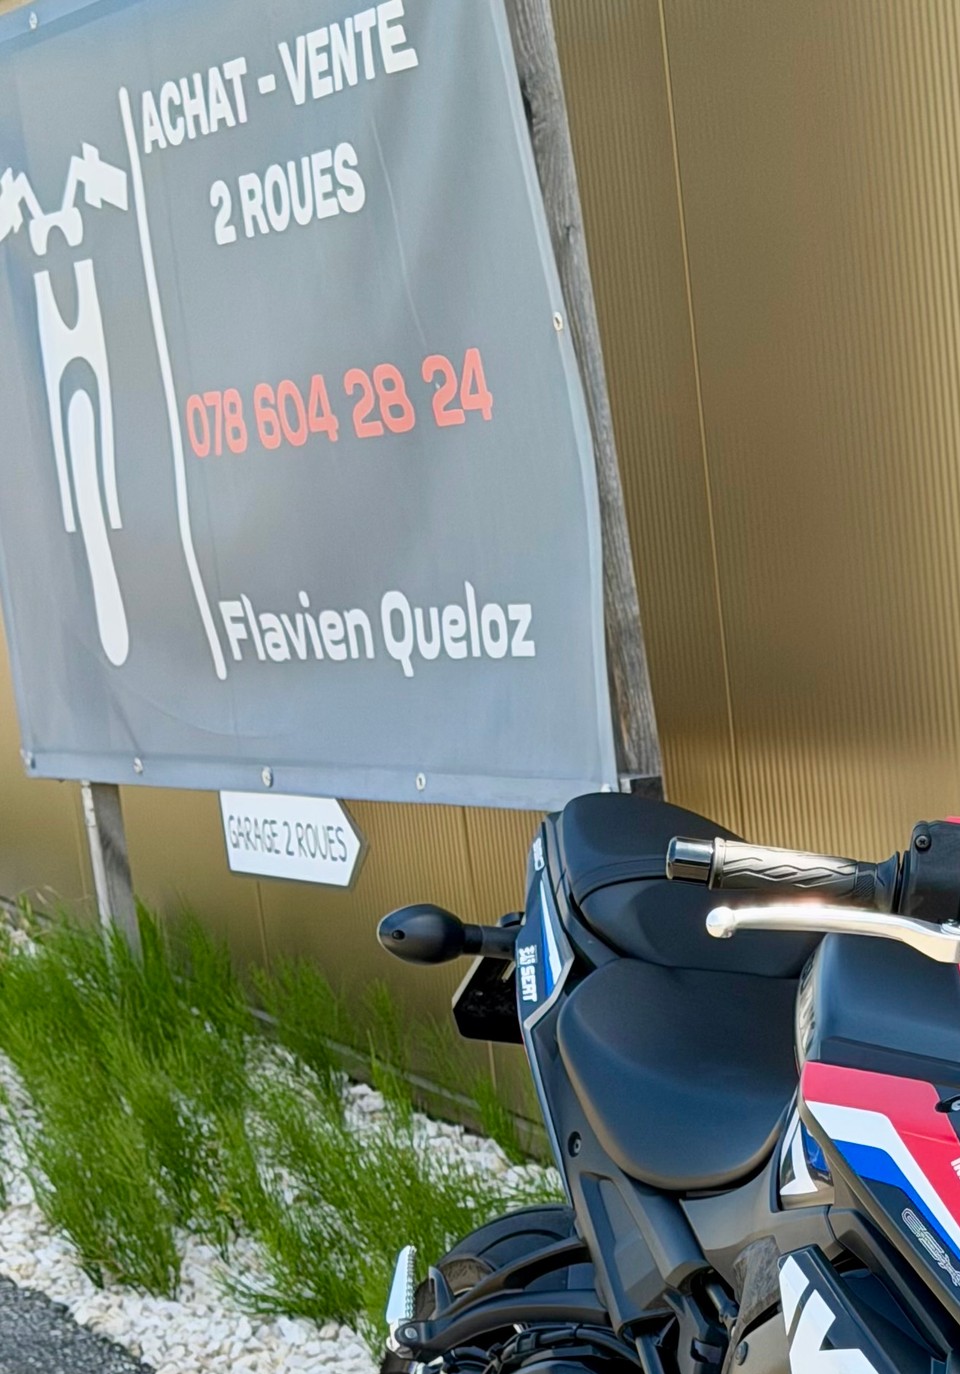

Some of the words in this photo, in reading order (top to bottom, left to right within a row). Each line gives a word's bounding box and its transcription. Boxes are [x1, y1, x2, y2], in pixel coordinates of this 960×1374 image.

[142, 57, 248, 153] ACHAT
[278, 0, 419, 105] VENTE
[209, 180, 237, 245] 2
[238, 142, 366, 238] ROUES
[186, 388, 248, 457] 078
[253, 374, 339, 450] 604
[344, 363, 416, 439] 28
[421, 347, 493, 427] 24
[218, 590, 375, 662] Flavien
[380, 580, 536, 678] Queloz
[228, 814, 282, 855] GARAGE
[282, 821, 295, 856] 2
[295, 821, 348, 862] ROUES
